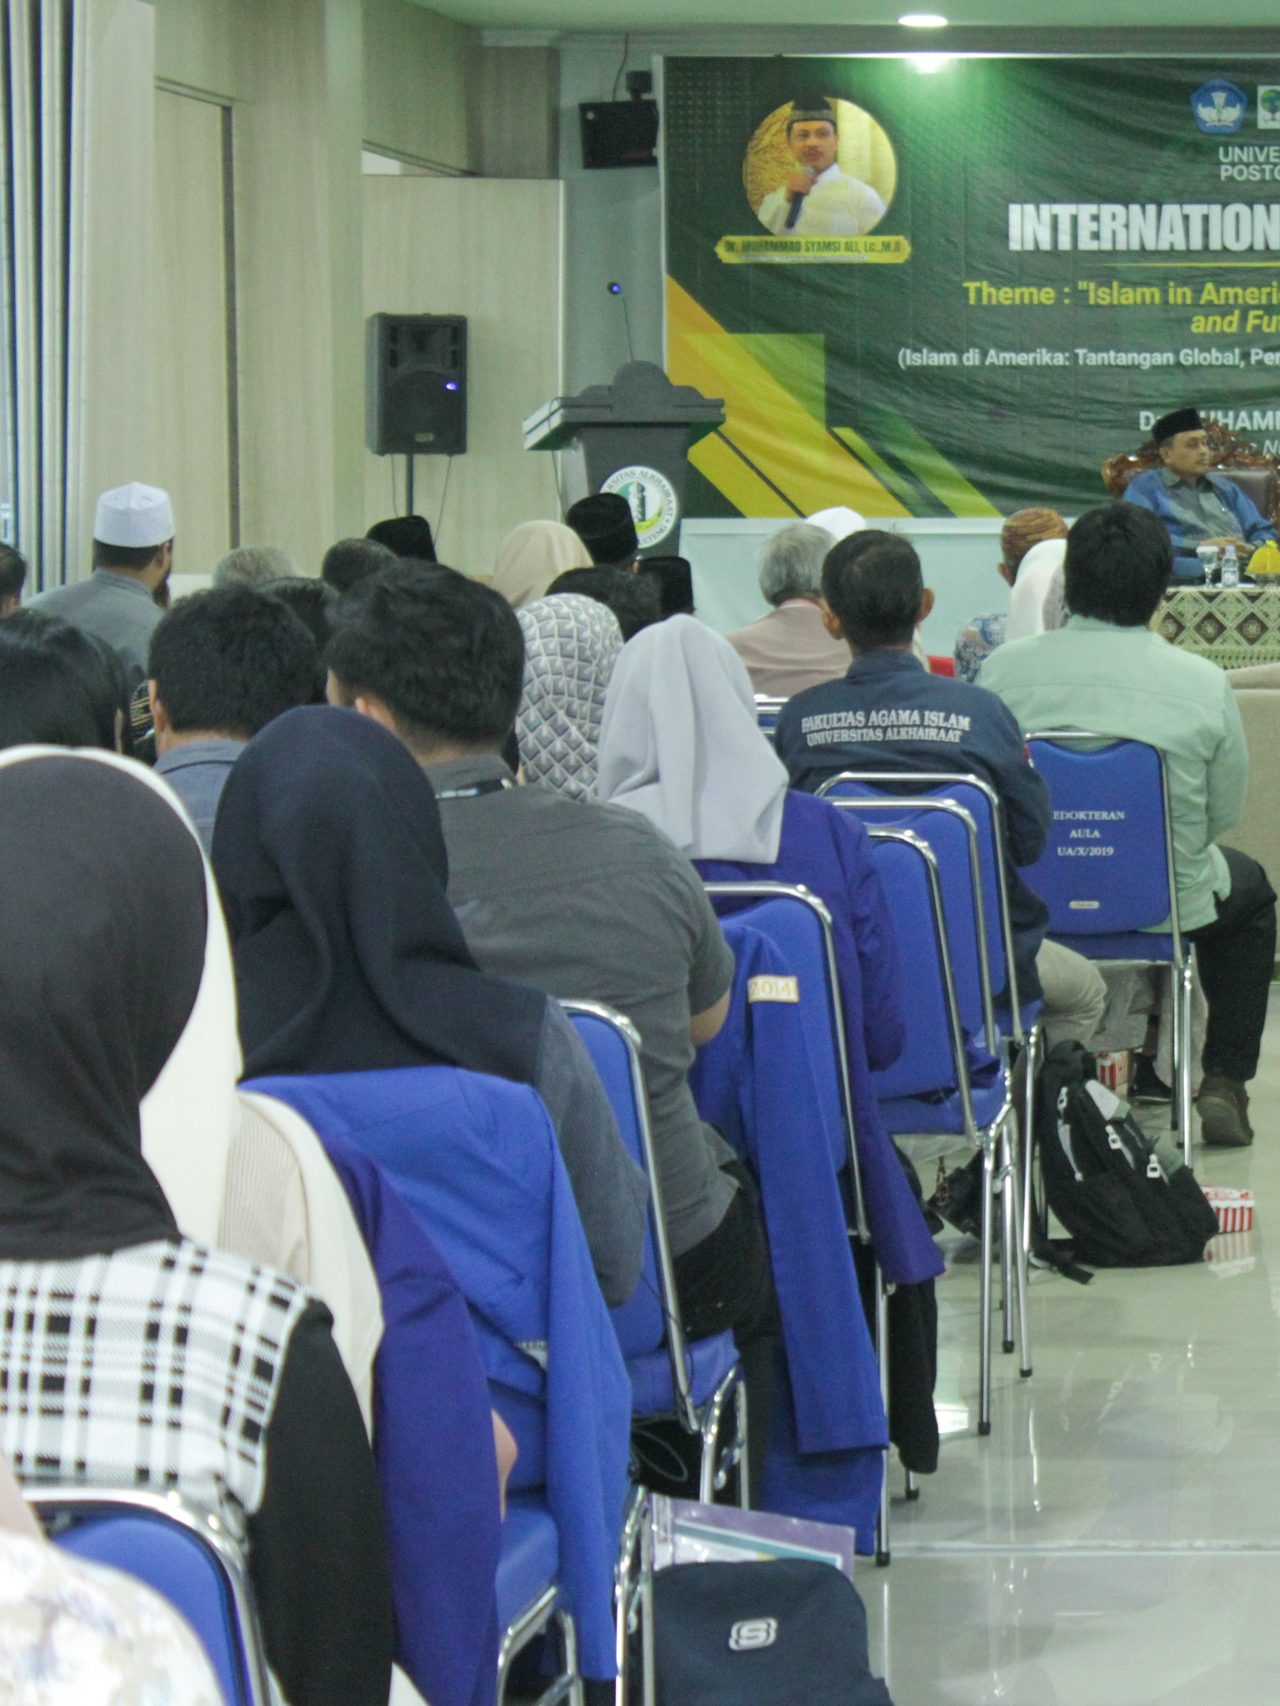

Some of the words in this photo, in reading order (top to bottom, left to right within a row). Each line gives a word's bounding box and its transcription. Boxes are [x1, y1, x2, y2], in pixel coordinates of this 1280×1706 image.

[742, 240, 801, 253] MUHAMMAD
[804, 240, 841, 252] SYAMSI
[964, 281, 1056, 305] Theme
[1078, 281, 1160, 304] "Islam
[1169, 282, 1191, 304] in
[1191, 310, 1240, 333] and
[898, 348, 958, 370] (Islam
[962, 348, 981, 366] di
[986, 348, 1070, 366] Amerika:
[1074, 349, 1174, 370] Tantangan
[1179, 348, 1246, 369] Global,
[801, 711, 866, 733] FAKULTAS
[868, 709, 921, 727] AGAMA
[923, 711, 972, 731] ISLAM
[806, 728, 884, 747] UNIVERSITAS
[885, 727, 963, 743] ALKHAIRAAT
[1069, 828, 1102, 838] AULA
[1057, 846, 1115, 856] UA/X/2019
